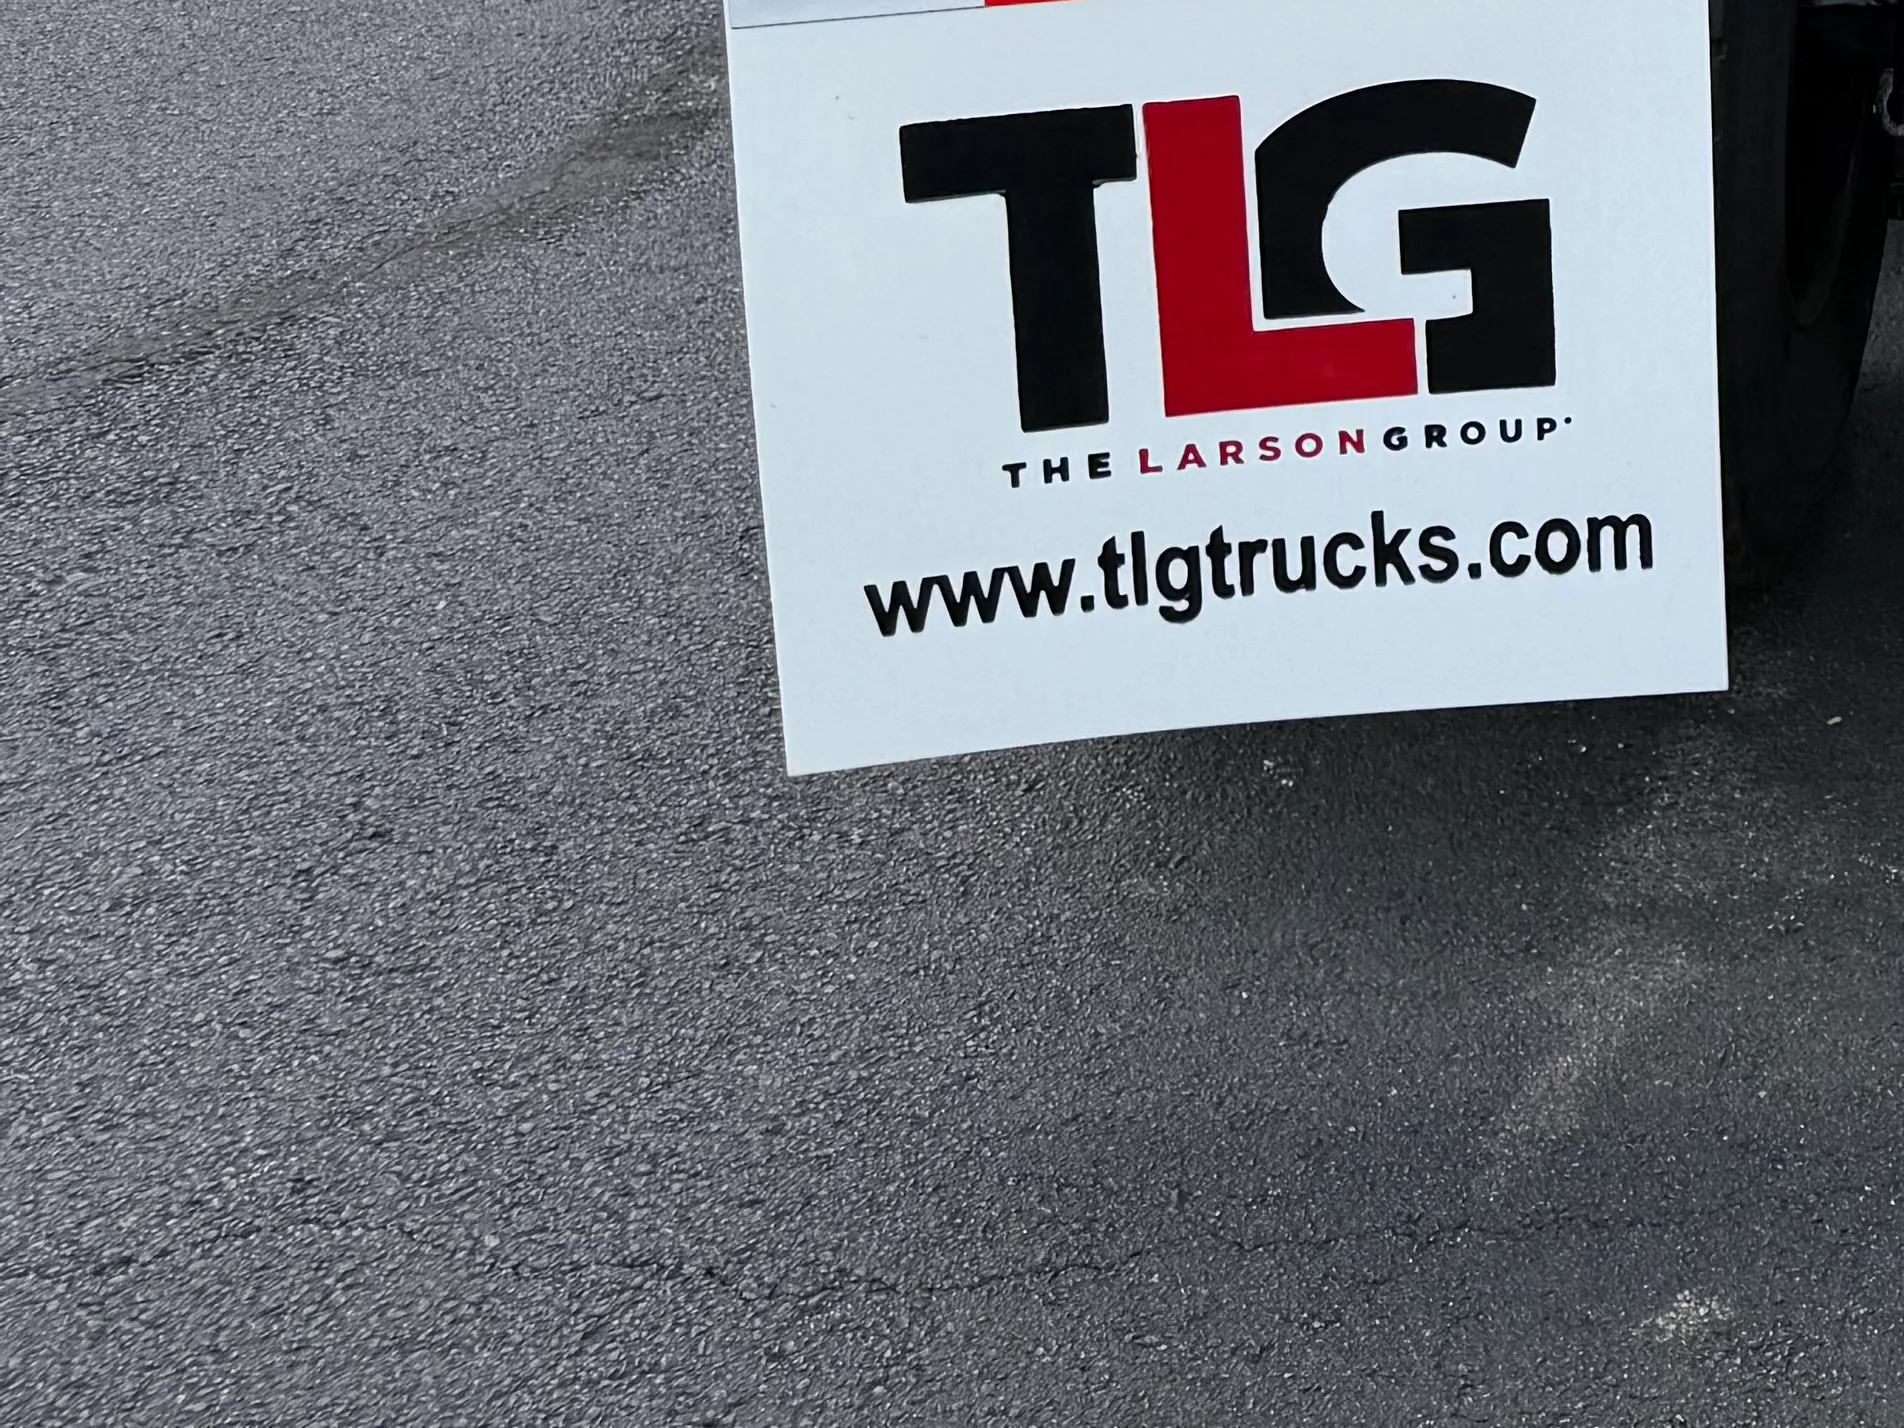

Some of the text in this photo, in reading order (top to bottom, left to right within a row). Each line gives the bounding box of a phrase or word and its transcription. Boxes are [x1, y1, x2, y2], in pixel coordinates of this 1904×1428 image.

[898, 78, 1557, 433] TLG
[1002, 451, 1112, 489] THE
[863, 509, 1655, 638] www.tlgtrucks.com
